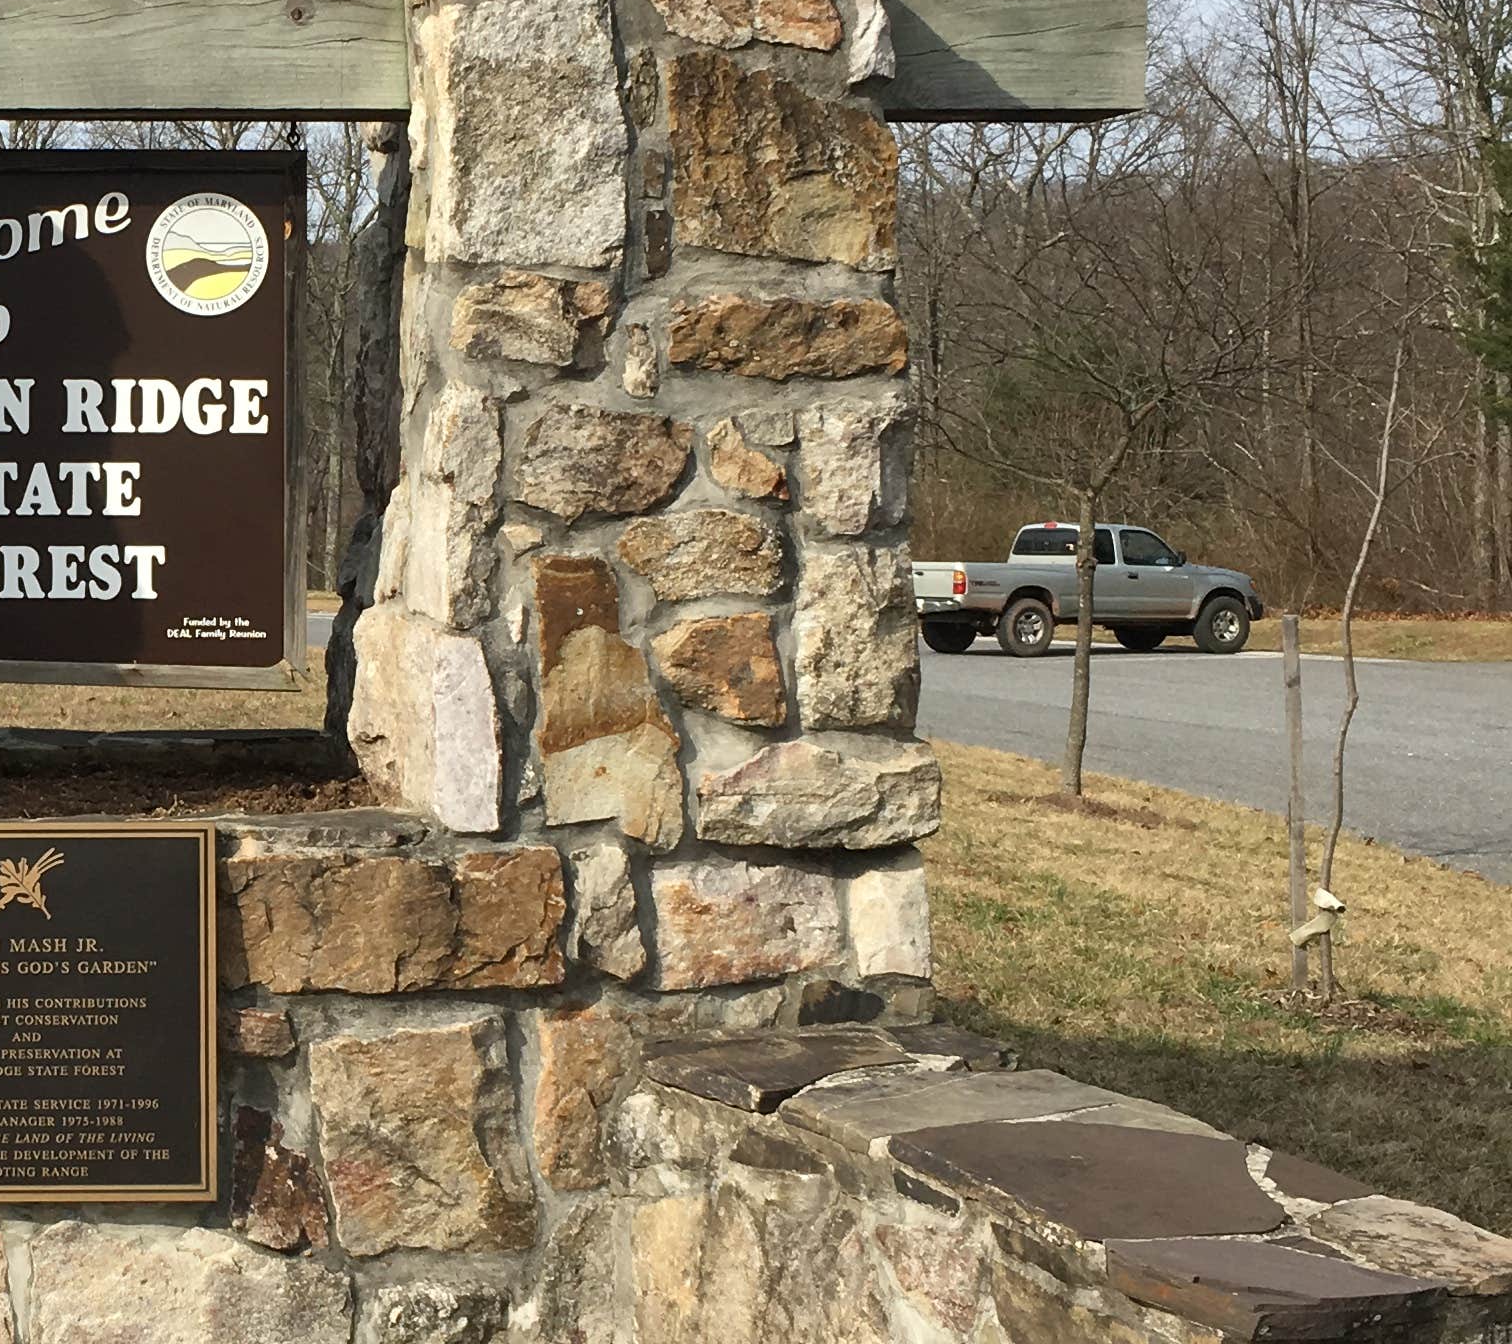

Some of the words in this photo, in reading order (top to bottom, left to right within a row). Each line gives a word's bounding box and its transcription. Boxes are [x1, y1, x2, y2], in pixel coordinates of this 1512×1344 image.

[160, 204, 184, 229] STATE
[187, 198, 201, 208] OF
[204, 197, 256, 229] MARYLAND
[151, 237, 178, 300] DEPARTMENT
[180, 296, 194, 308] OF
[196, 293, 243, 312] NATURAL
[242, 236, 265, 294] RESOURCES
[62, 378, 268, 435] RIDGE
[184, 617, 216, 626] Funded
[219, 617, 231, 628] by
[235, 617, 249, 626] the
[167, 629, 192, 638] DEAL
[196, 629, 226, 640] Family
[229, 630, 266, 638] Reunion
[10, 939, 66, 952] MASH
[76, 939, 103, 952] JR.
[7, 998, 28, 1009] HIS
[35, 998, 146, 1008] CONTRIBUTIONS
[16, 1015, 118, 1025] CONSERVATION
[12, 1032, 41, 1043] AND
[2, 1049, 100, 1059] PRESERVATION
[106, 1048, 122, 1059] AT
[28, 1065, 68, 1076] STATE
[74, 1065, 125, 1075] FOREST
[34, 1099, 90, 1110] SERVICE
[99, 1099, 158, 1109] 1971-1996
[63, 1116, 123, 1127] 1975-1988
[16, 1133, 49, 1144] LAND
[56, 1133, 73, 1144] OF
[80, 1133, 104, 1143] THE
[111, 1132, 154, 1143] LIVING
[14, 1150, 114, 1160] DEVELOPMENT
[121, 1149, 137, 1160] OF
[143, 1149, 169, 1159] THE
[43, 1166, 88, 1177] RANGE
